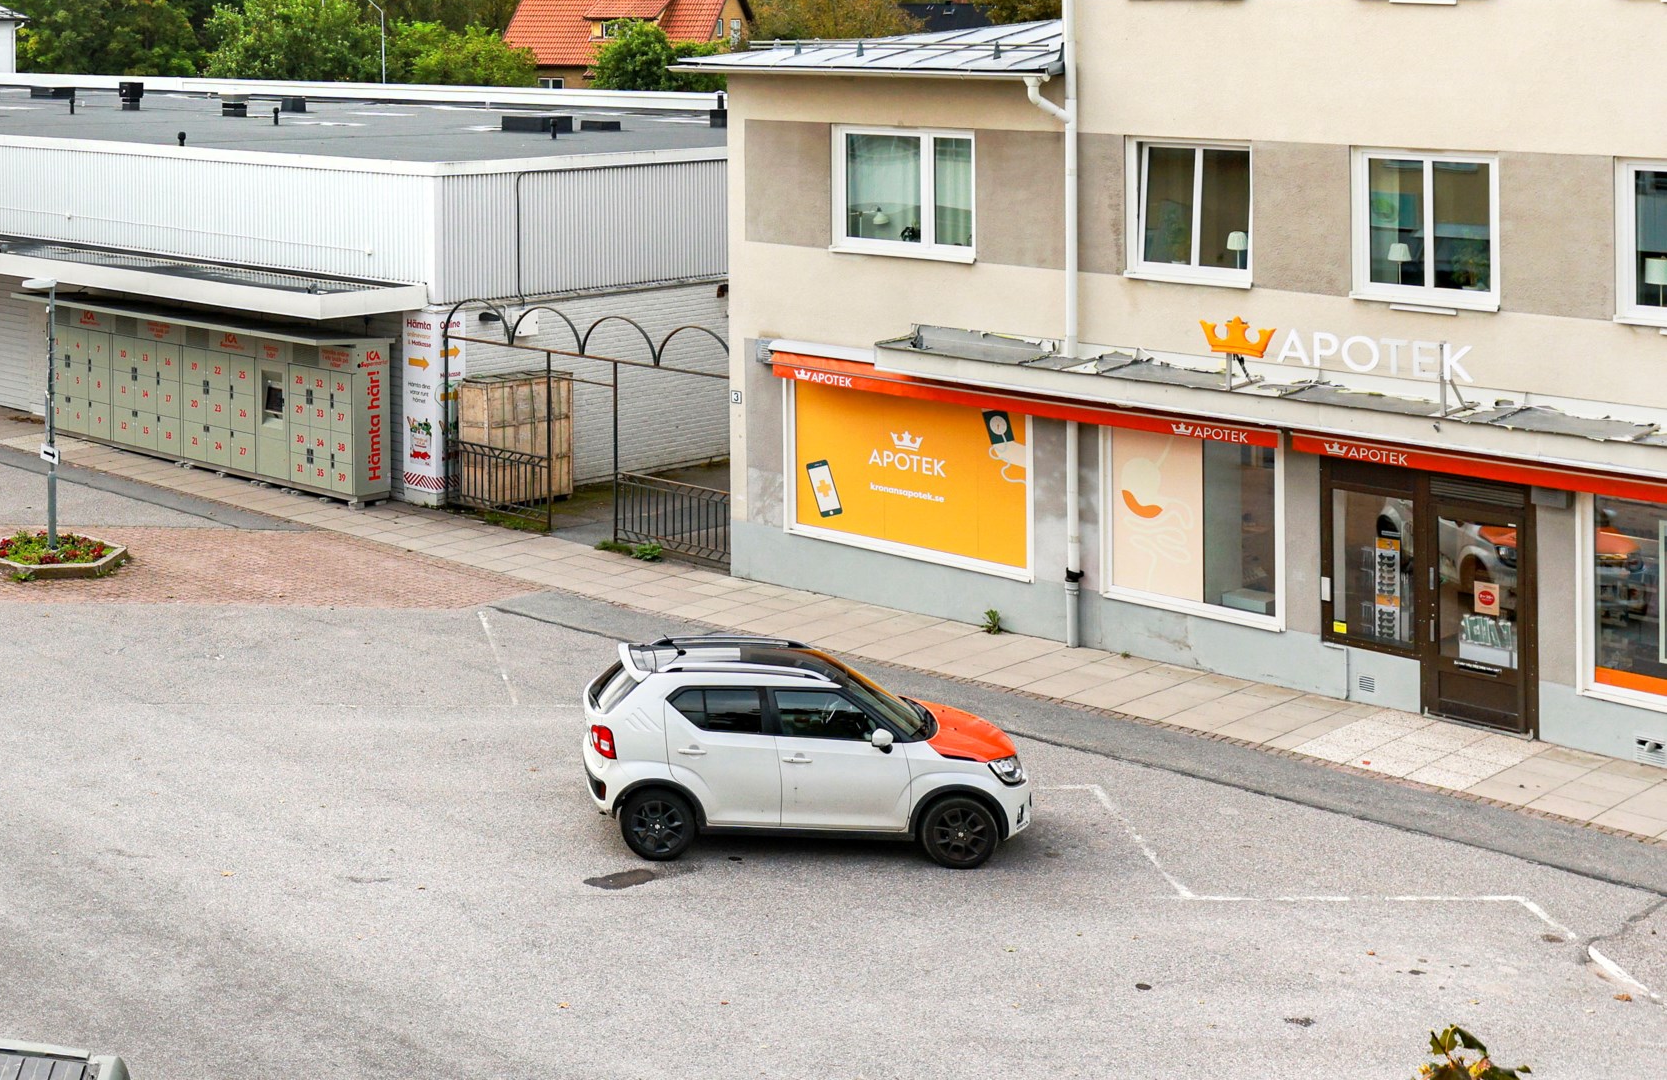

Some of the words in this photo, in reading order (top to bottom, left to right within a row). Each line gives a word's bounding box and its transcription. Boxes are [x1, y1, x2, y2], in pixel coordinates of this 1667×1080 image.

[84, 310, 95, 320] ICA
[406, 319, 432, 330] Hämta
[225, 333, 238, 344] ICA
[412, 340, 431, 348] Matkasse
[120, 349, 126, 358] 10
[366, 351, 381, 361] ICA
[1276, 328, 1474, 383] APOTEK
[165, 357, 171, 366] 16
[192, 362, 198, 370] 19
[214, 366, 221, 375] 22
[239, 370, 246, 379] 25
[56, 372, 60, 380] 2
[295, 376, 303, 384] 28
[811, 372, 852, 388] APOTEK
[316, 379, 323, 388] 32
[337, 382, 344, 391] 36
[408, 381, 421, 389] Hämta
[121, 386, 126, 394] 11
[142, 390, 149, 398] 14
[367, 370, 380, 410] här!
[165, 394, 171, 402] 17
[734, 392, 739, 402] 3
[191, 400, 198, 408] 20
[214, 404, 221, 413] 23
[239, 409, 246, 418] 26
[296, 405, 303, 414] 29
[317, 409, 324, 418] 33
[98, 416, 102, 424] 9
[337, 413, 344, 421] 37
[143, 426, 149, 434] 15
[1194, 426, 1248, 443] APOTEK
[165, 431, 171, 439] 18
[297, 435, 304, 443] 30
[192, 437, 197, 445] 21
[317, 439, 324, 447] 34
[215, 442, 222, 450] 24
[338, 443, 345, 451] 38
[367, 414, 381, 481] Hämta
[239, 447, 246, 456] 27
[1348, 447, 1408, 466] APOTEK
[869, 448, 946, 478] APOTEK
[297, 464, 303, 472] 31
[317, 469, 324, 477] 35
[338, 473, 346, 482] 39
[870, 482, 945, 502] kronansapotek.se
